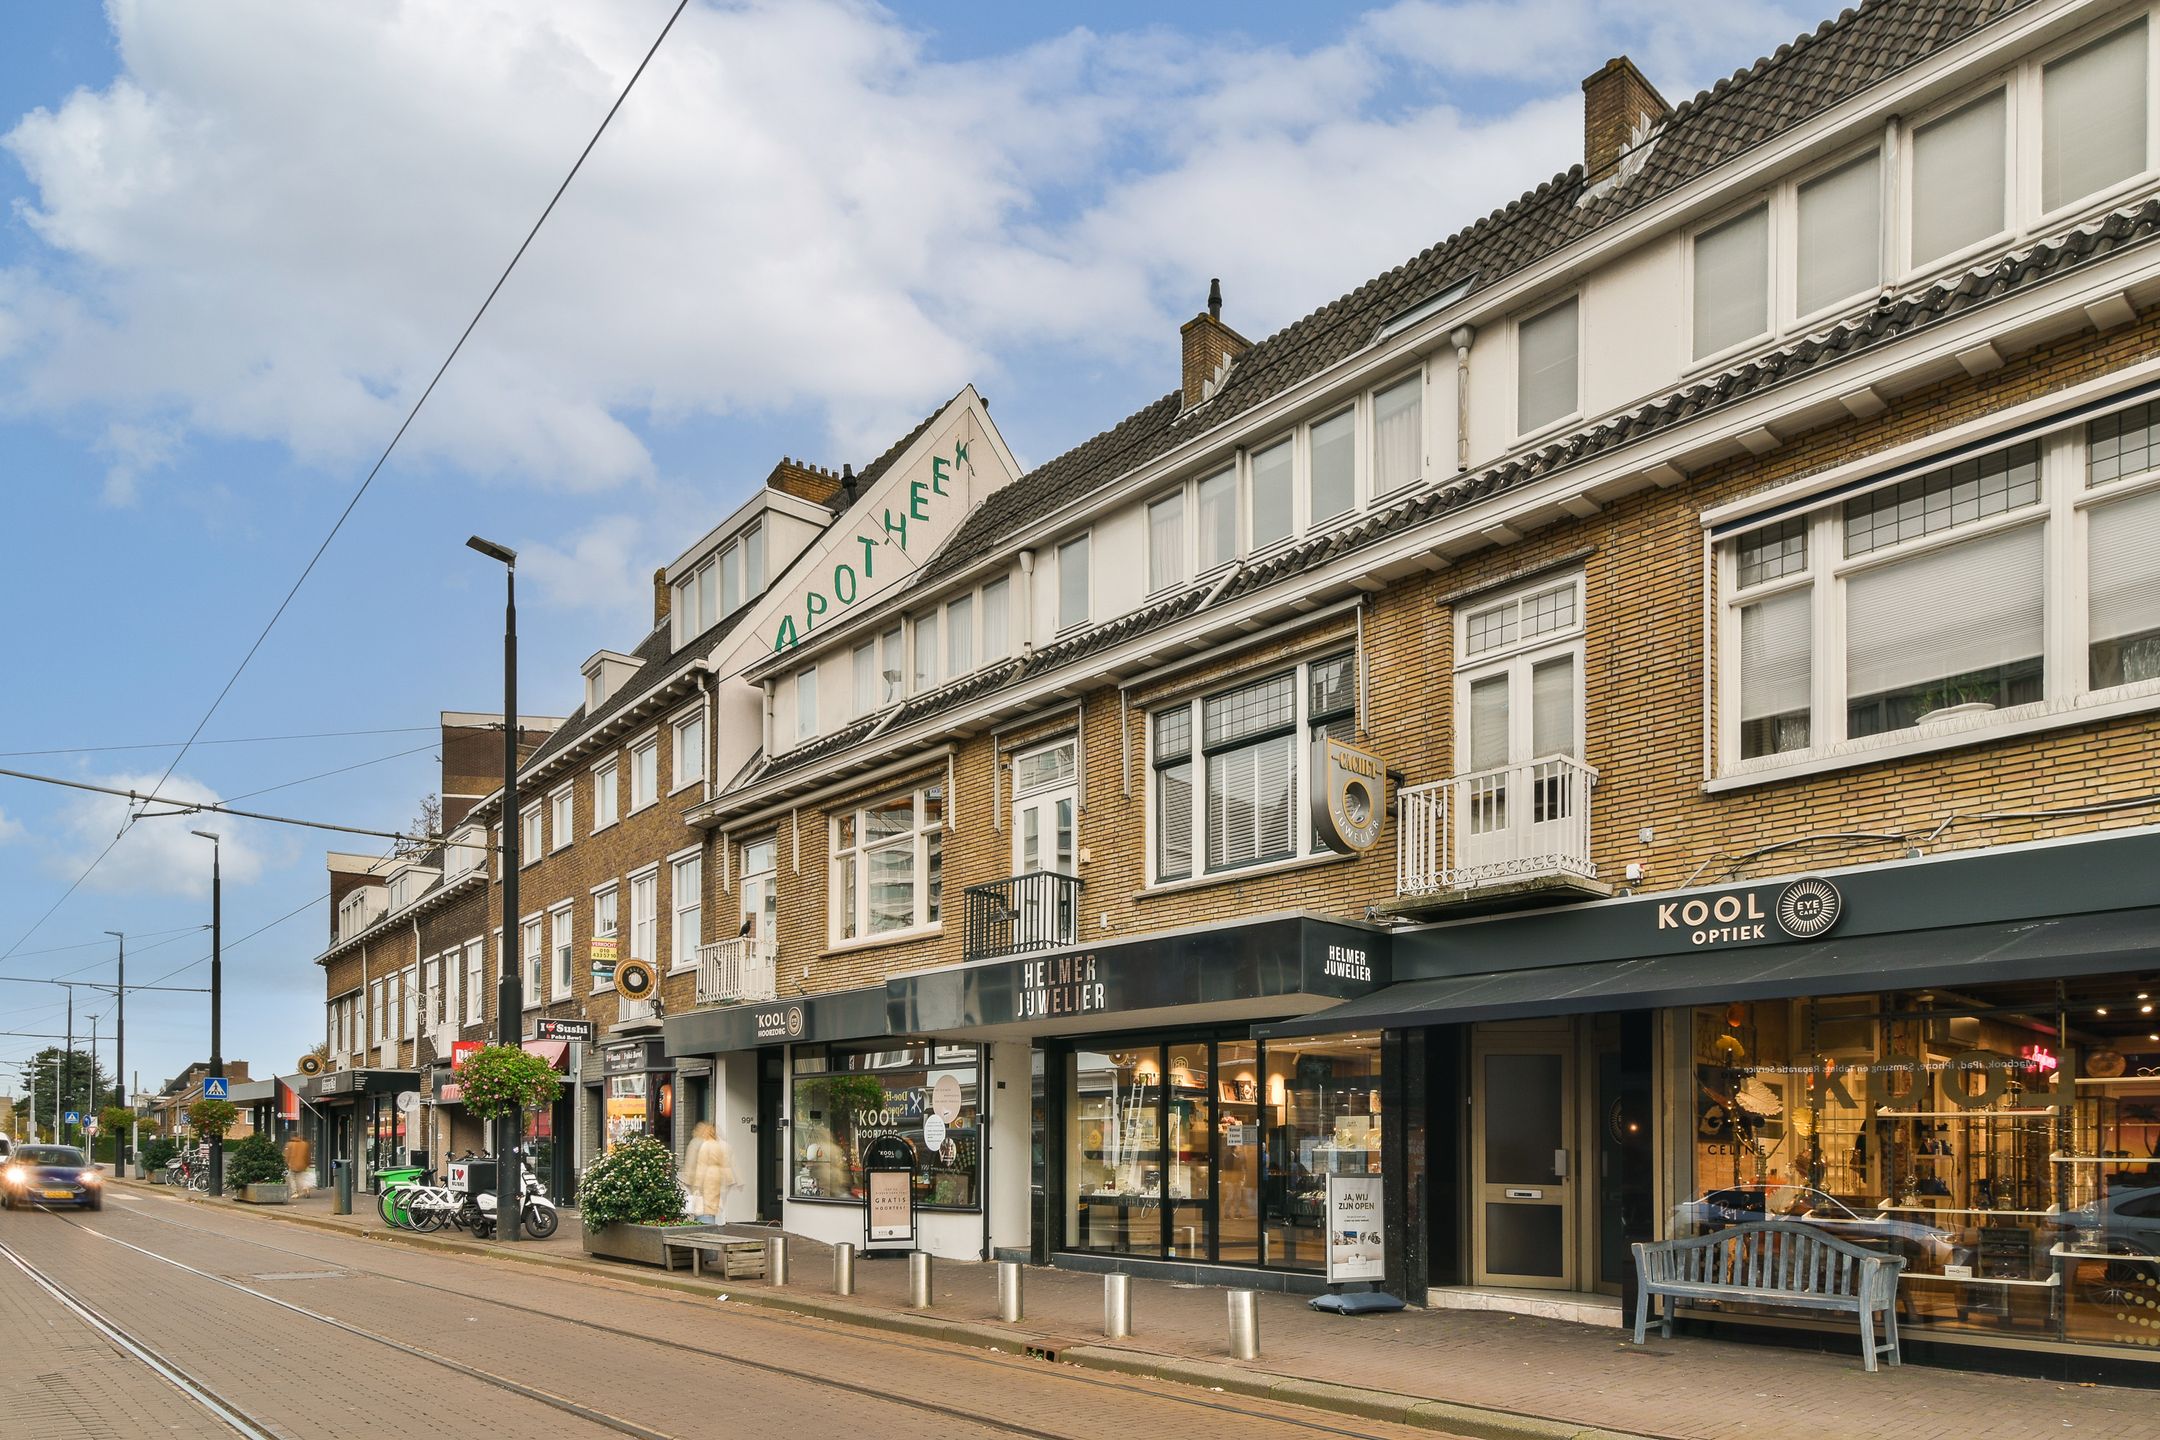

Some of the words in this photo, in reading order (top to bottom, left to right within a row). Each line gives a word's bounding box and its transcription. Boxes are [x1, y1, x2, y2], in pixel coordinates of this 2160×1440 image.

[774, 437, 976, 653] APOTHEEK
[1334, 807, 1379, 842] JUWELIER
[1658, 893, 1765, 929] KOOL
[1797, 900, 1820, 910] EYE
[1692, 924, 1766, 945] OPTIEK
[1329, 945, 1366, 966] HELMER
[1024, 954, 1096, 988] HELMER
[1324, 960, 1371, 981] JUWELIER
[1017, 983, 1104, 1017] JUWELIER
[556, 1024, 588, 1034] Sushi
[758, 1012, 786, 1028] KOOL
[757, 1028, 786, 1037] HOORZORG
[859, 1109, 898, 1126] KOOL
[1708, 1145, 1766, 1155] CELINE
[1338, 1202, 1354, 1210] ZIJN
[1354, 1202, 1375, 1210] OPEN
[1343, 1193, 1354, 1202] JA,
[1355, 1193, 1369, 1201] WIJ
